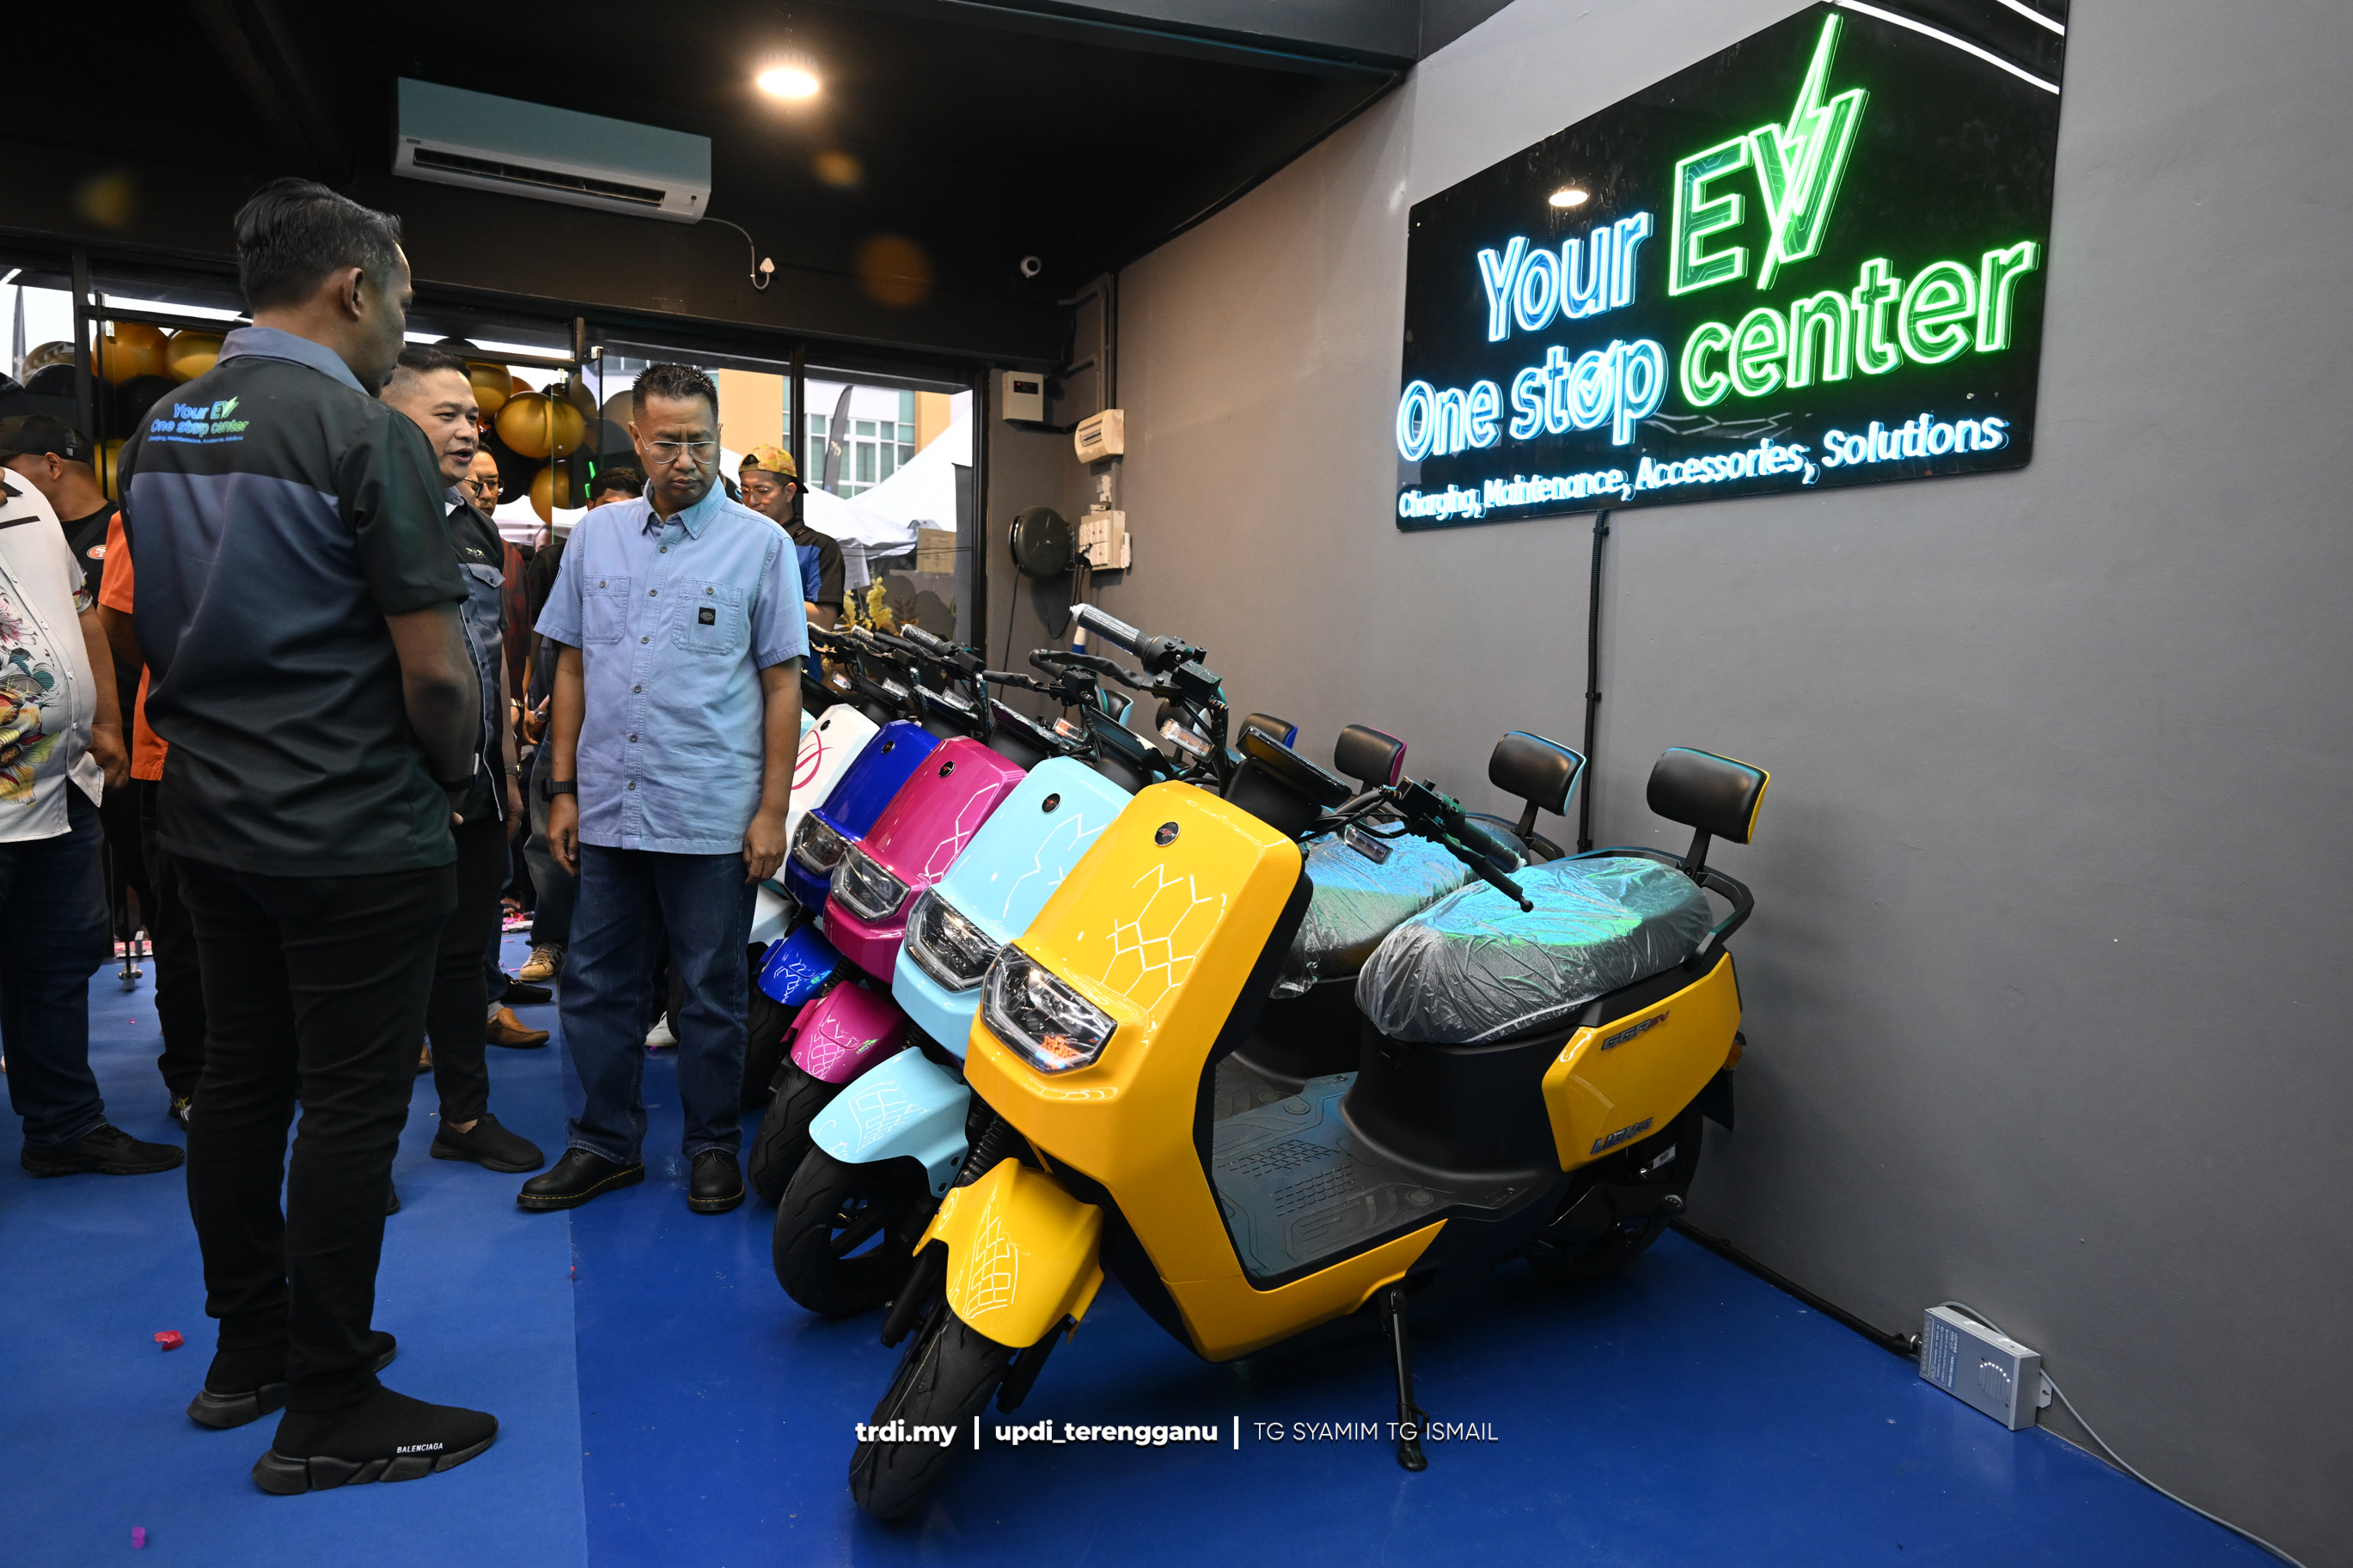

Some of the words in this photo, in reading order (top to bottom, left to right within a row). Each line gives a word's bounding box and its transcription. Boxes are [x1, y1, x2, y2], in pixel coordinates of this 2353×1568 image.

[1477, 211, 1653, 342] Your
[1669, 60, 1870, 296] EV
[1397, 380, 1504, 461] One
[1510, 339, 1669, 446] stop
[1680, 241, 2040, 406] center
[150, 418, 175, 433] One
[176, 419, 210, 438] stop
[210, 419, 249, 435] center
[174, 403, 210, 419] Your
[210, 396, 240, 420] EV
[1398, 484, 1487, 521] Charging,
[1483, 469, 1635, 509] Maintenance,
[1635, 437, 1820, 491] Accessories,
[1820, 413, 2009, 467] Solutions
[396, 1442, 444, 1454] BALENCIAGA
